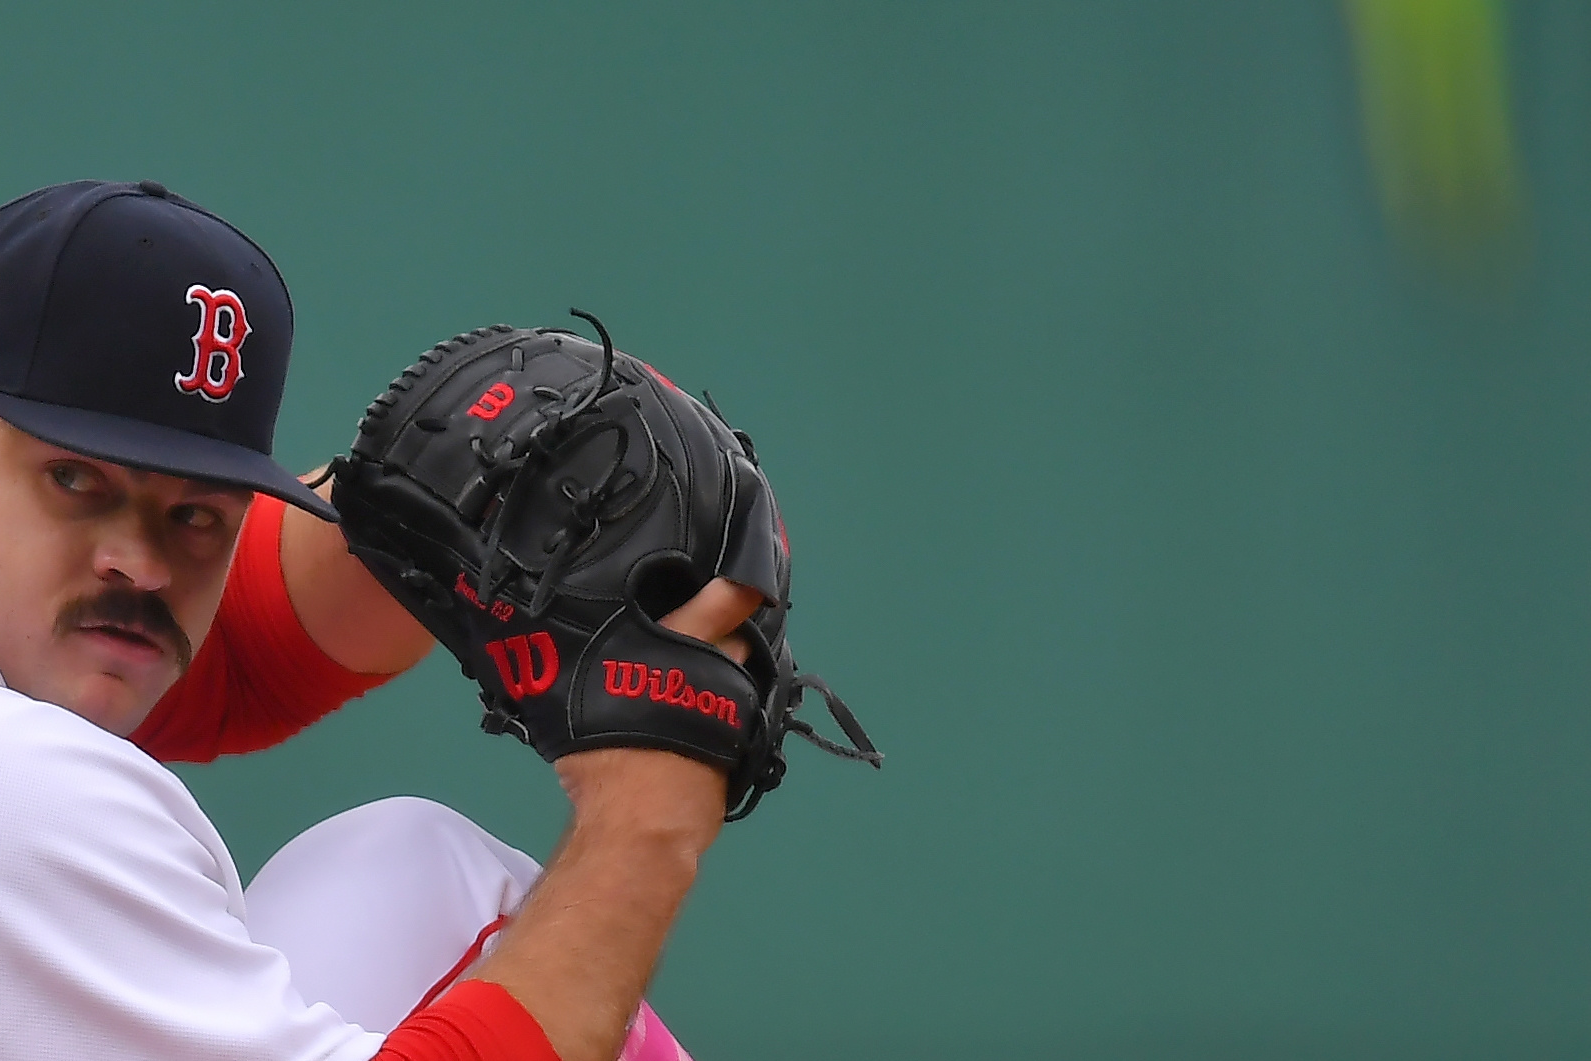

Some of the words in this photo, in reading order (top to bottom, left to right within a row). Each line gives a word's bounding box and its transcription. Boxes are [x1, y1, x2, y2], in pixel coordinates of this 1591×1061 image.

[174, 284, 253, 403] B
[485, 631, 559, 701] W
[603, 659, 742, 729] Wilson
